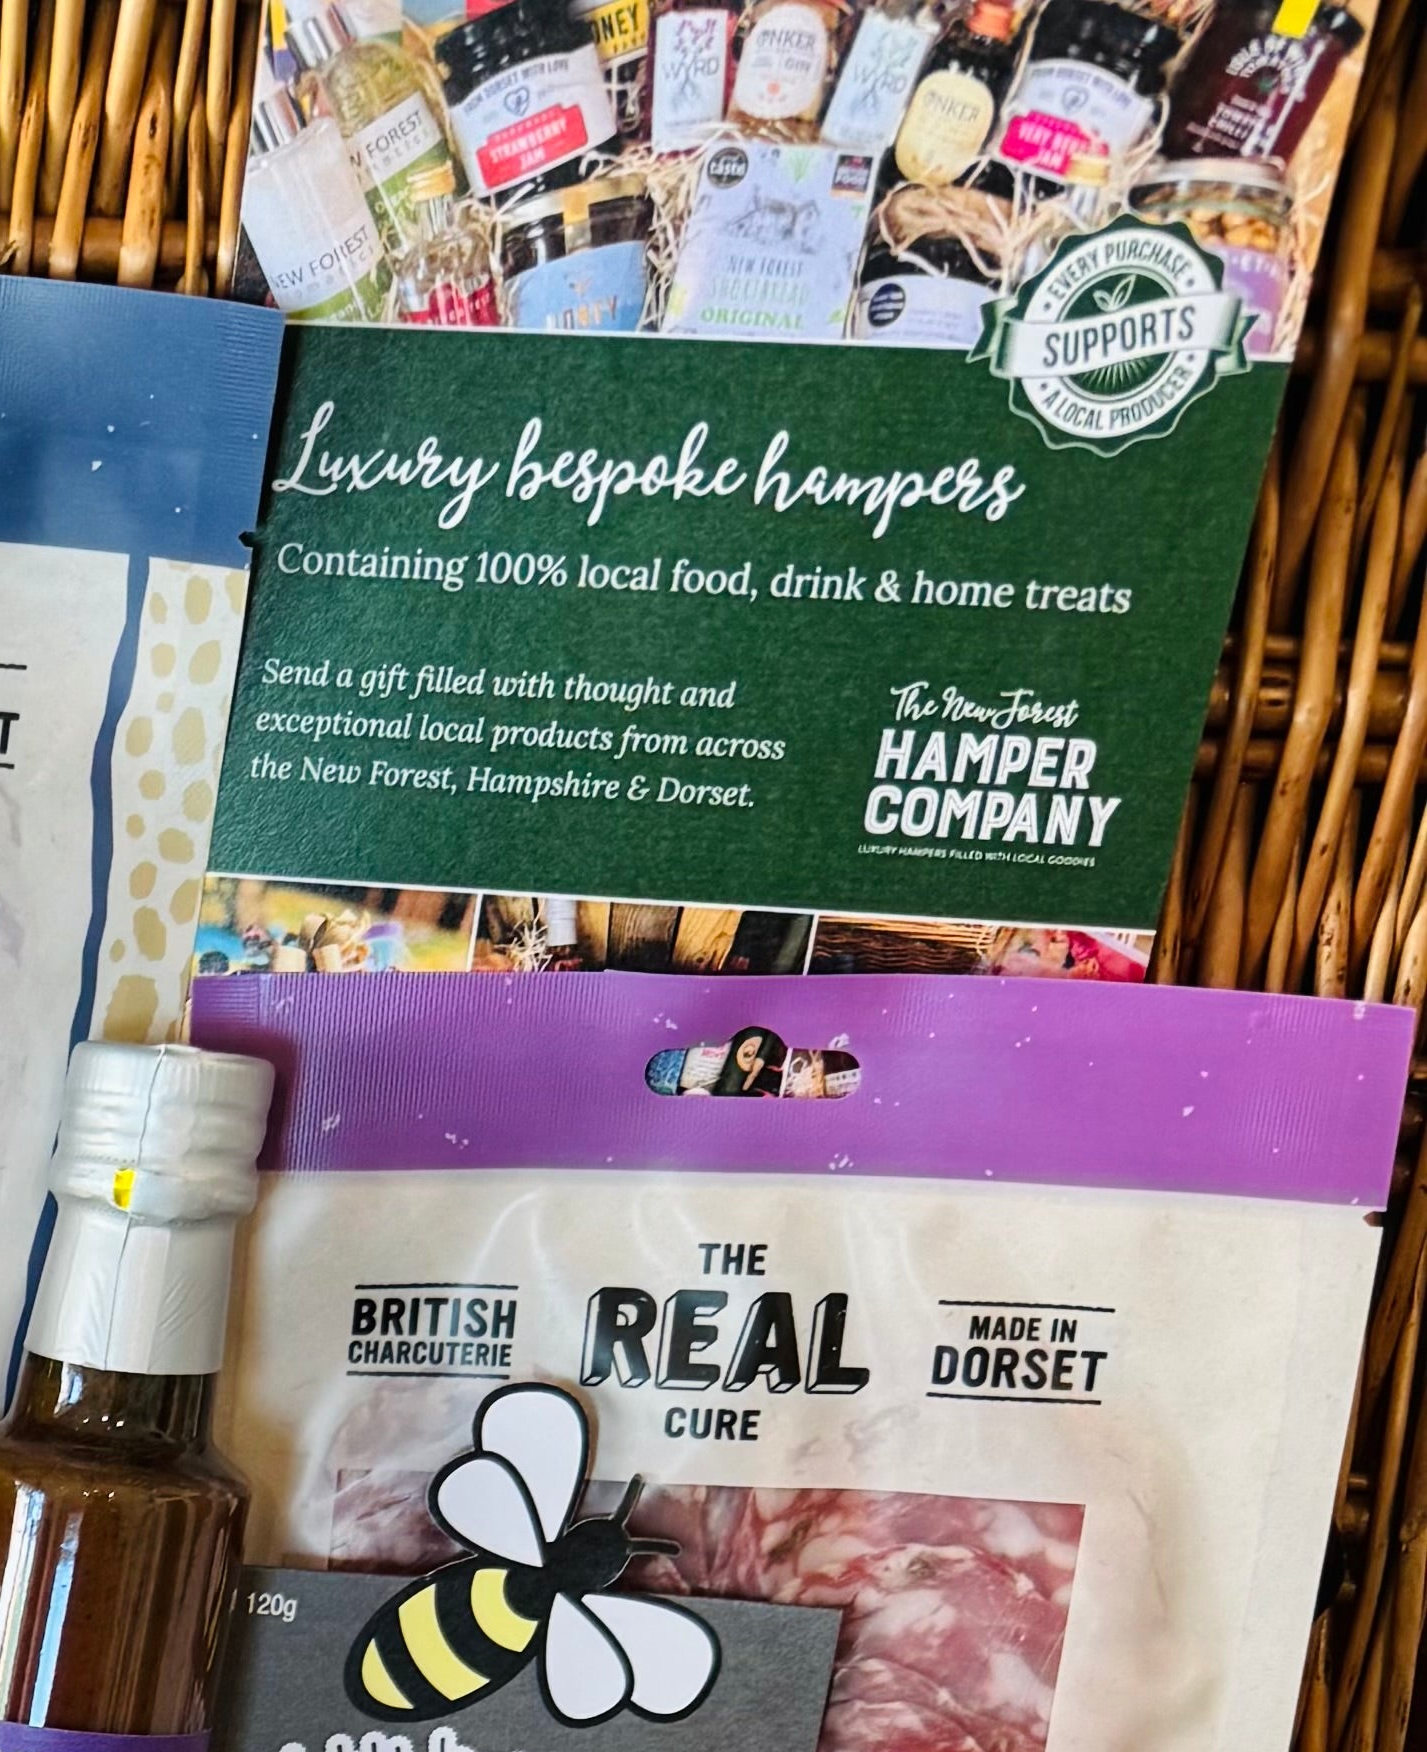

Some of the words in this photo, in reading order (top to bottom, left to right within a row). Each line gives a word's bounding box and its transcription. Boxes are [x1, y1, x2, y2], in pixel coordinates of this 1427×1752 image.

[1049, 251, 1101, 302] EVERY
[1105, 238, 1192, 281] PURCHASE
[700, 307, 804, 332] ORIGINAL
[1045, 305, 1196, 369] SUPPORTS
[1055, 395, 1105, 431] LOCAL
[1109, 366, 1195, 429] PRODUCER
[272, 400, 501, 530] Luxury
[504, 420, 746, 527] bespoke
[756, 428, 1026, 540] hampers
[276, 543, 468, 591] Containing
[476, 551, 568, 588] 100%
[577, 559, 661, 593] local
[669, 561, 758, 602] food,
[769, 564, 865, 603] drink
[874, 569, 901, 605] &
[910, 569, 1015, 611] home
[1023, 577, 1132, 616] treats
[872, 728, 1100, 790] HAMPER
[862, 784, 1122, 848] COMPANY
[347, 1339, 513, 1370] CHARCUTERIE
[579, 1286, 871, 1397] REAL
[932, 1345, 1108, 1393] DORSET
[246, 1592, 298, 1623] 120g
